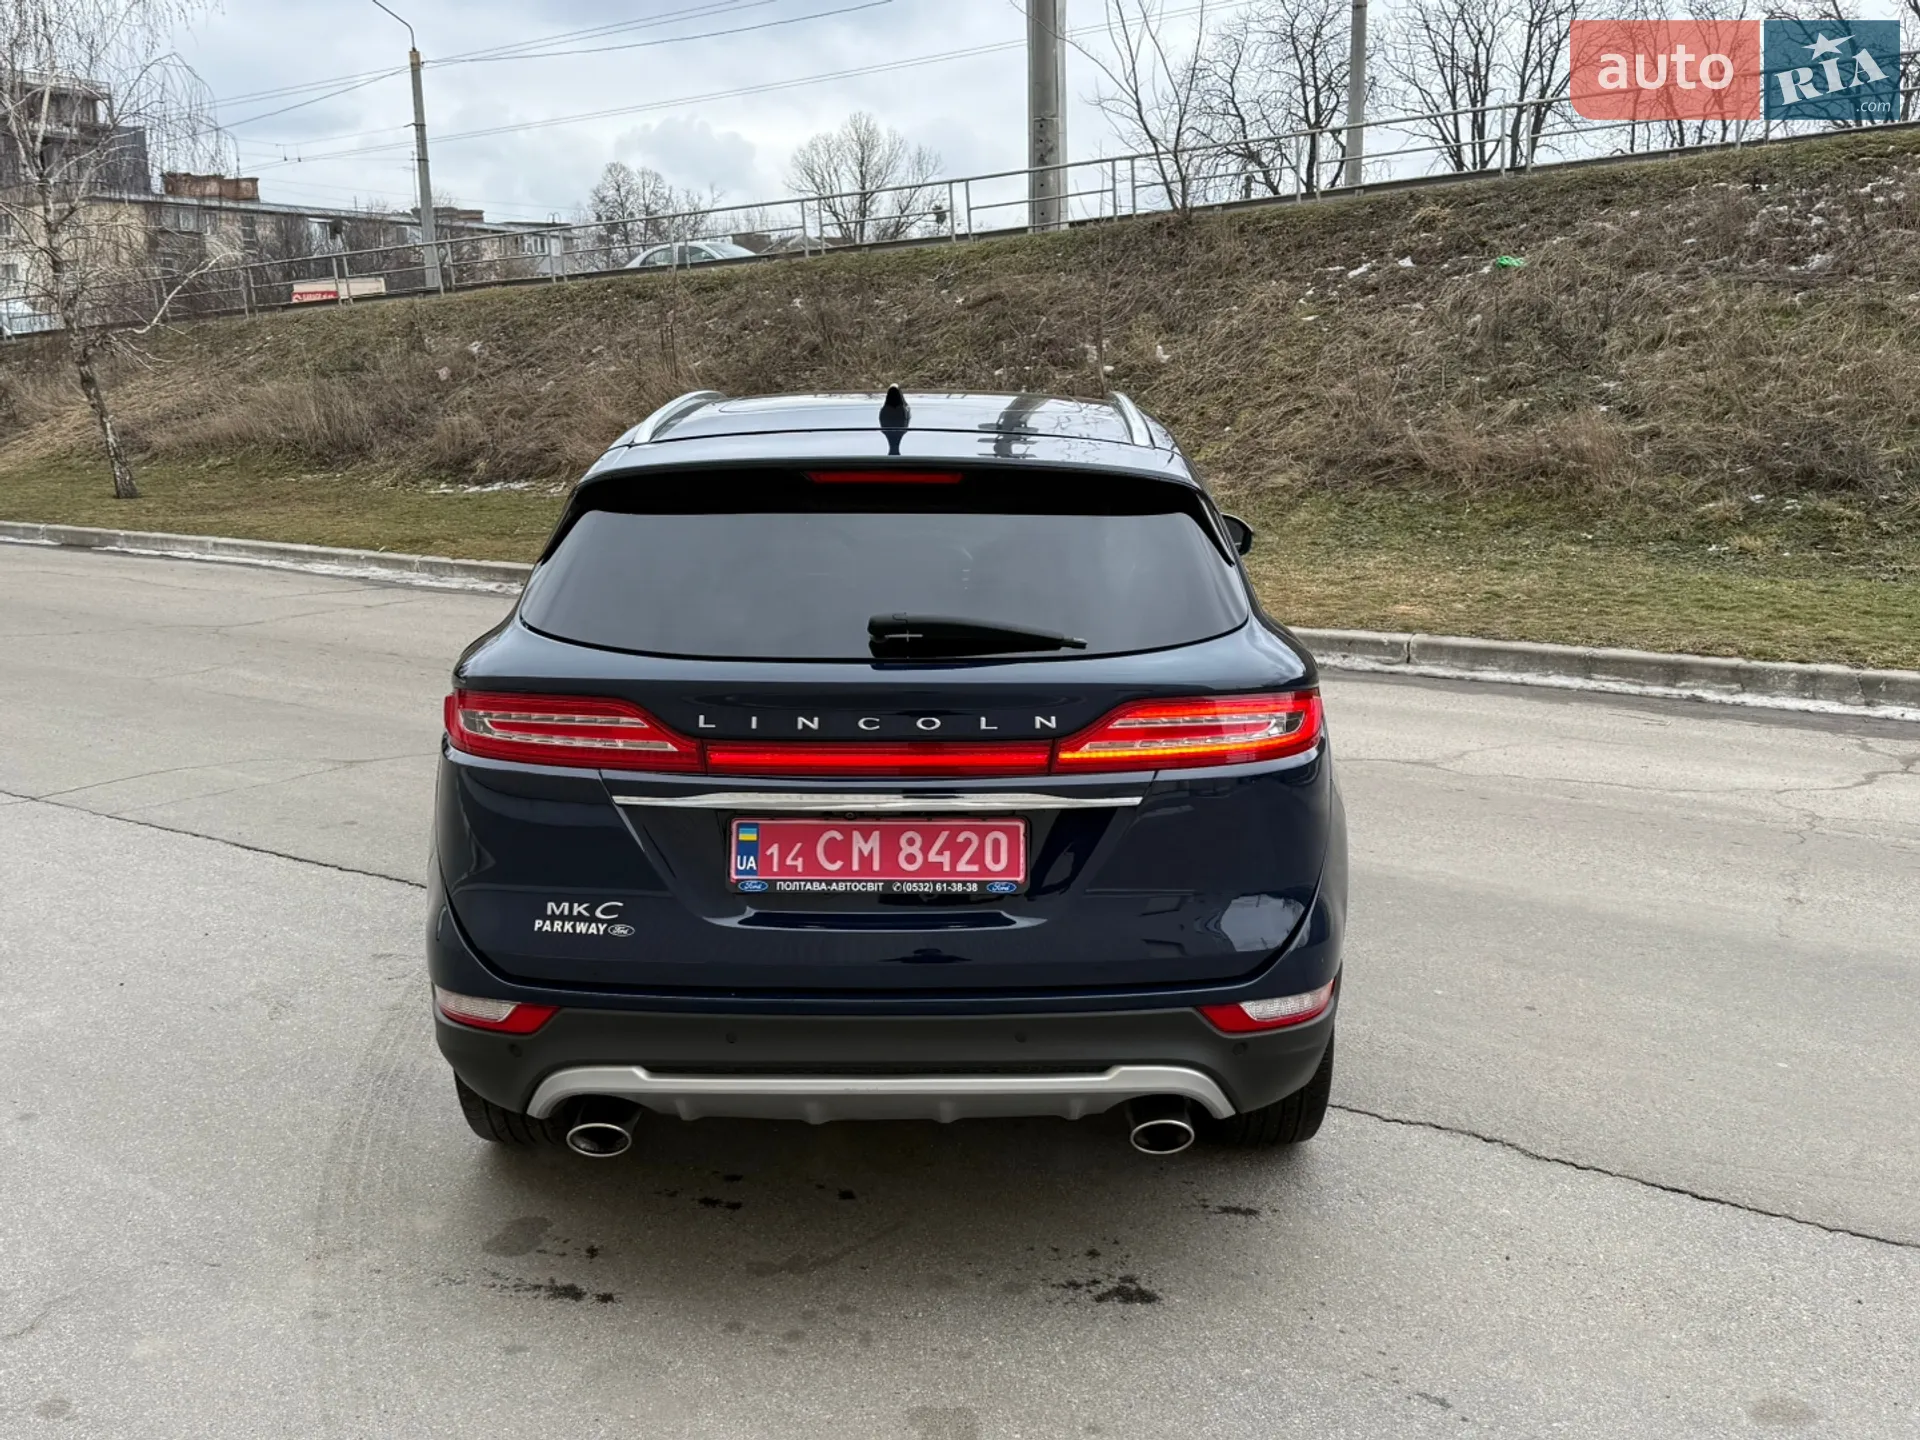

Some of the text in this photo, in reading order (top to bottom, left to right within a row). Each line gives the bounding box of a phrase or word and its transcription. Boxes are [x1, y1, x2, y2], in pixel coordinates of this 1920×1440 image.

[698, 715, 1057, 731] LINCOLN
[765, 829, 1009, 873] 14 CM 8420
[737, 855, 757, 871] UA
[741, 881, 765, 891] Ford
[776, 881, 978, 893] ПОЛТАВА-АВТОСВІТ (0532) 61-38-38
[989, 882, 1013, 892] Ford
[546, 901, 624, 919] MKC
[534, 919, 632, 936] PARKWAY Ford
